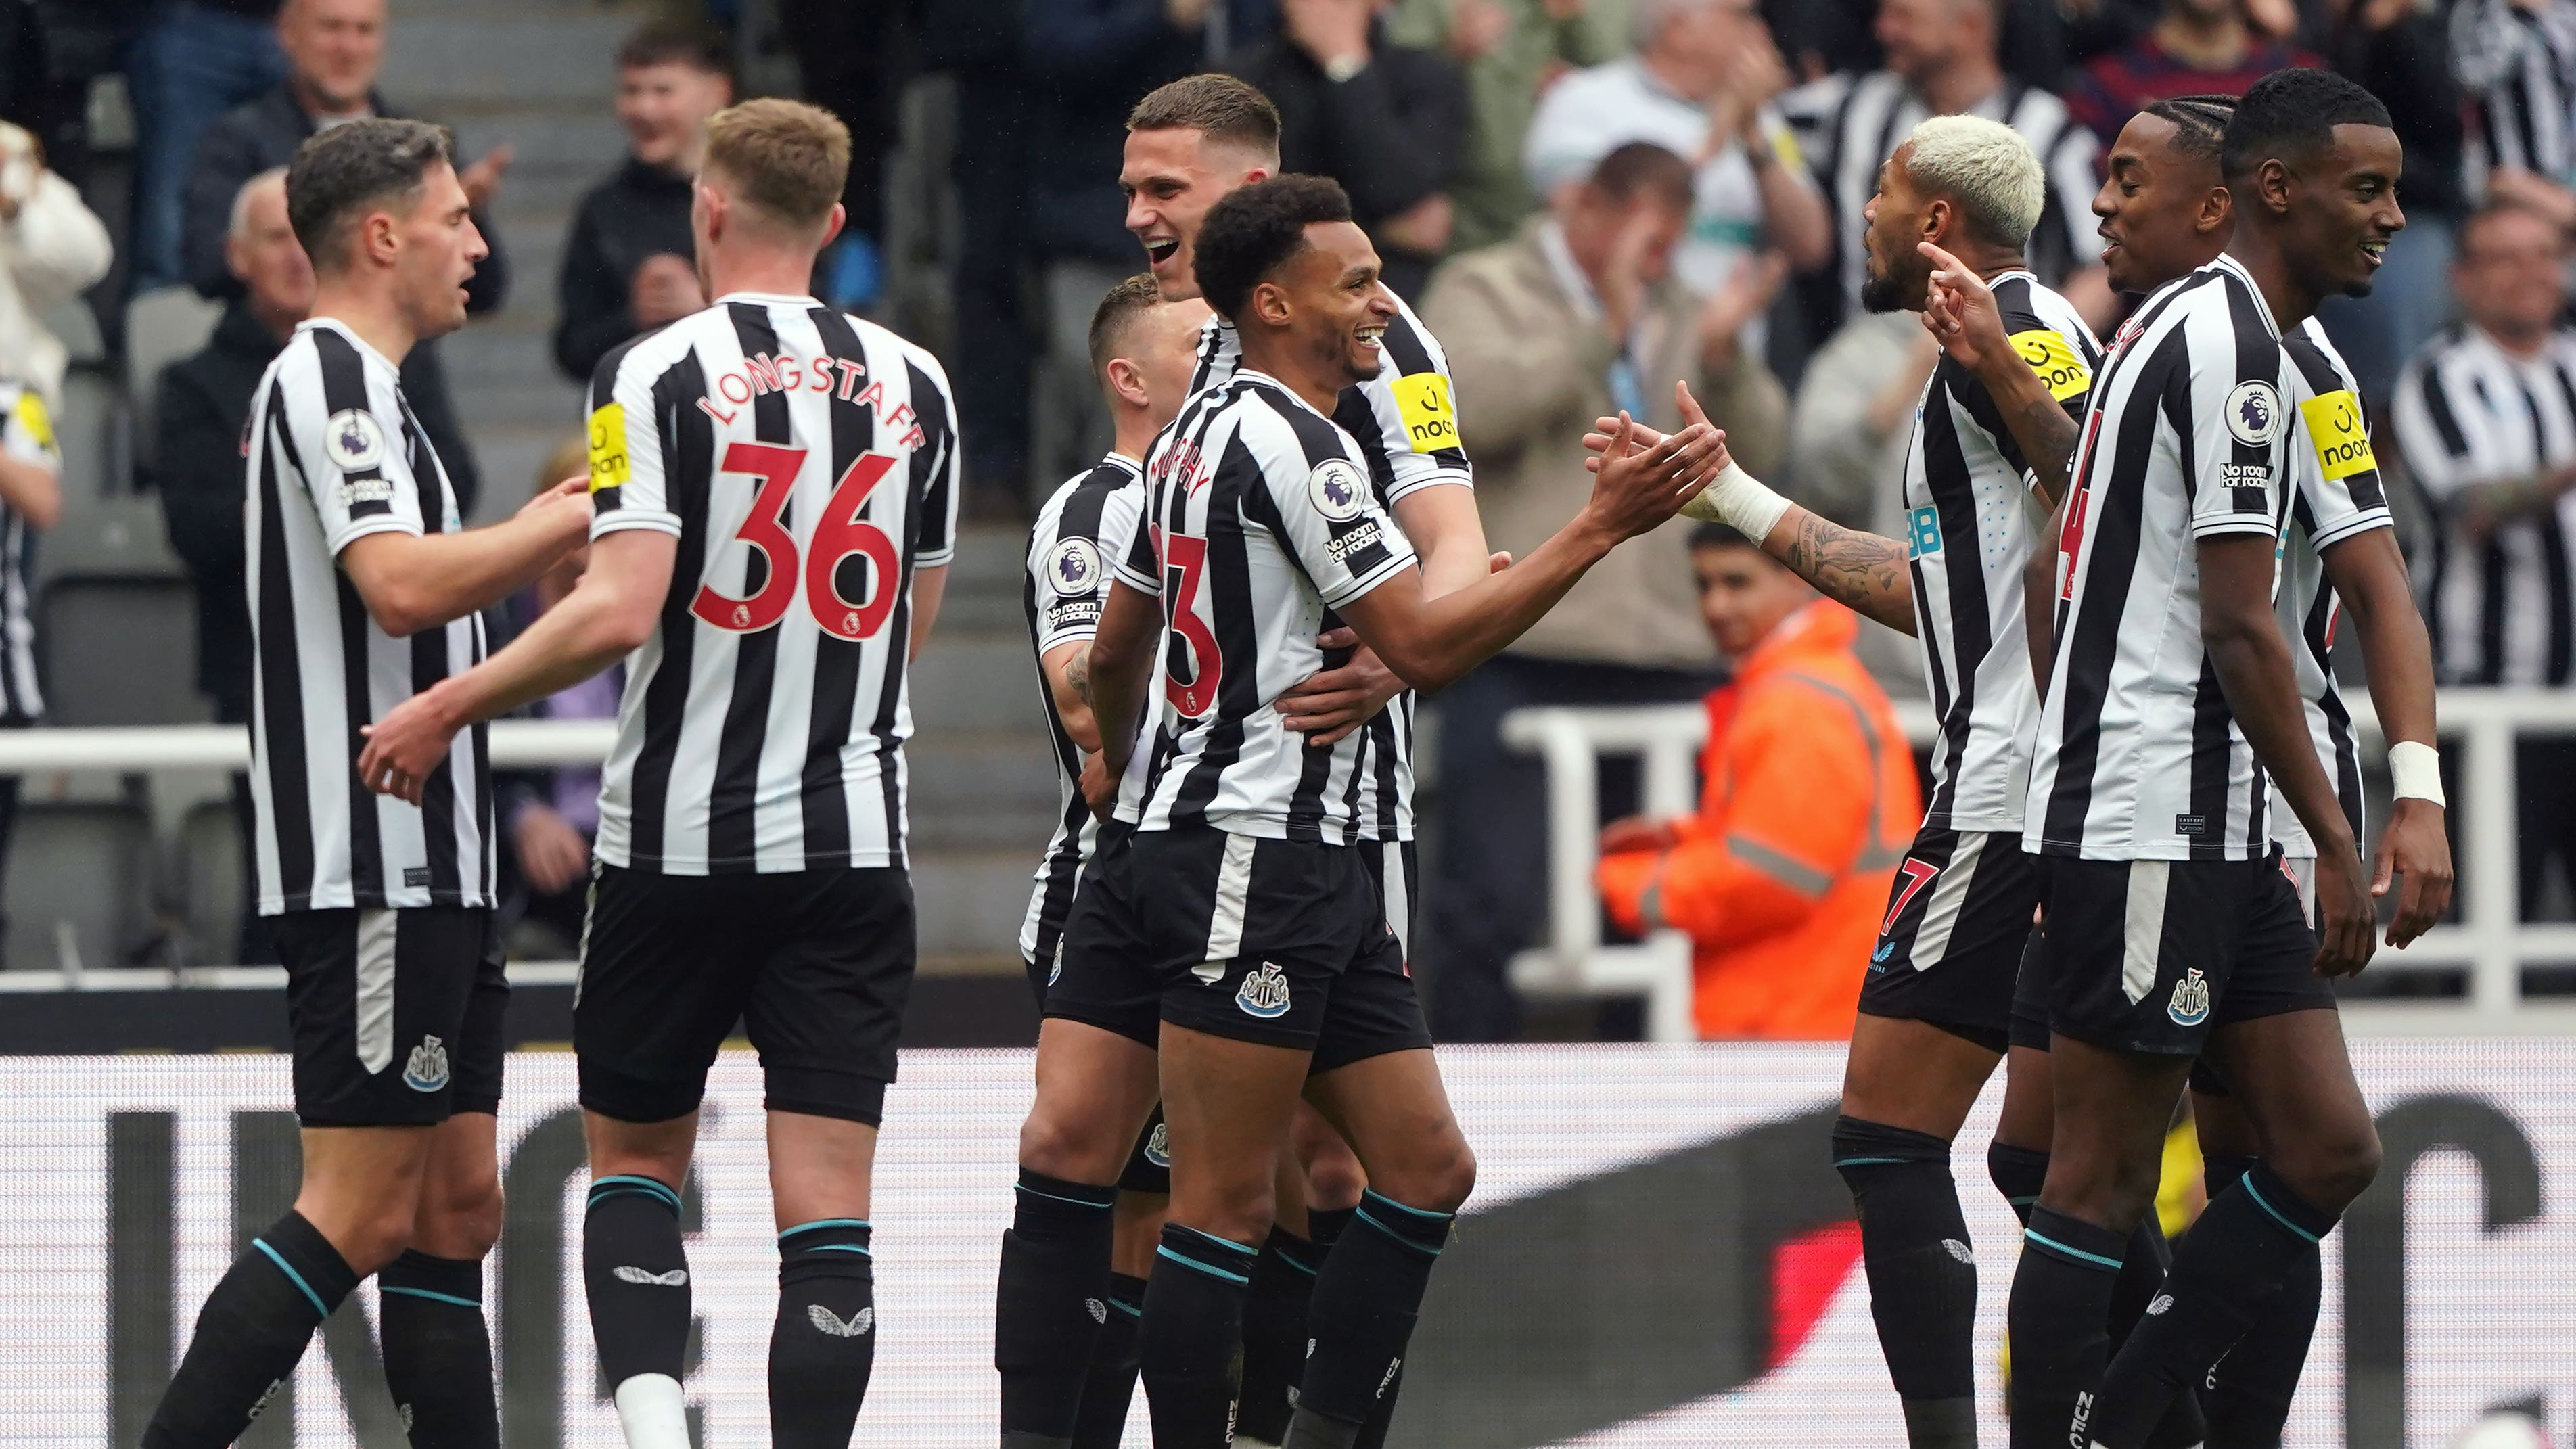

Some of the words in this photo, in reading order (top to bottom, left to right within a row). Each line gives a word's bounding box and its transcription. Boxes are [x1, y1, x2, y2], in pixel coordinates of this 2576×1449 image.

[696, 351, 927, 453] LONGSTAFF
[2323, 438, 2372, 466] noon
[2220, 464, 2241, 476] No
[2220, 476, 2242, 488] for
[688, 442, 902, 643] 36
[1323, 538, 1343, 553] No
[1342, 522, 1375, 545] room
[1328, 547, 1347, 564] for
[1346, 529, 1385, 555] racism
[1046, 607, 1061, 620] No
[1061, 601, 1096, 613] room
[1059, 610, 1101, 623] racism
[1881, 856, 1940, 936] 7
[1376, 1357, 1401, 1399] NUFC
[2069, 1391, 2094, 1449] NUFC
